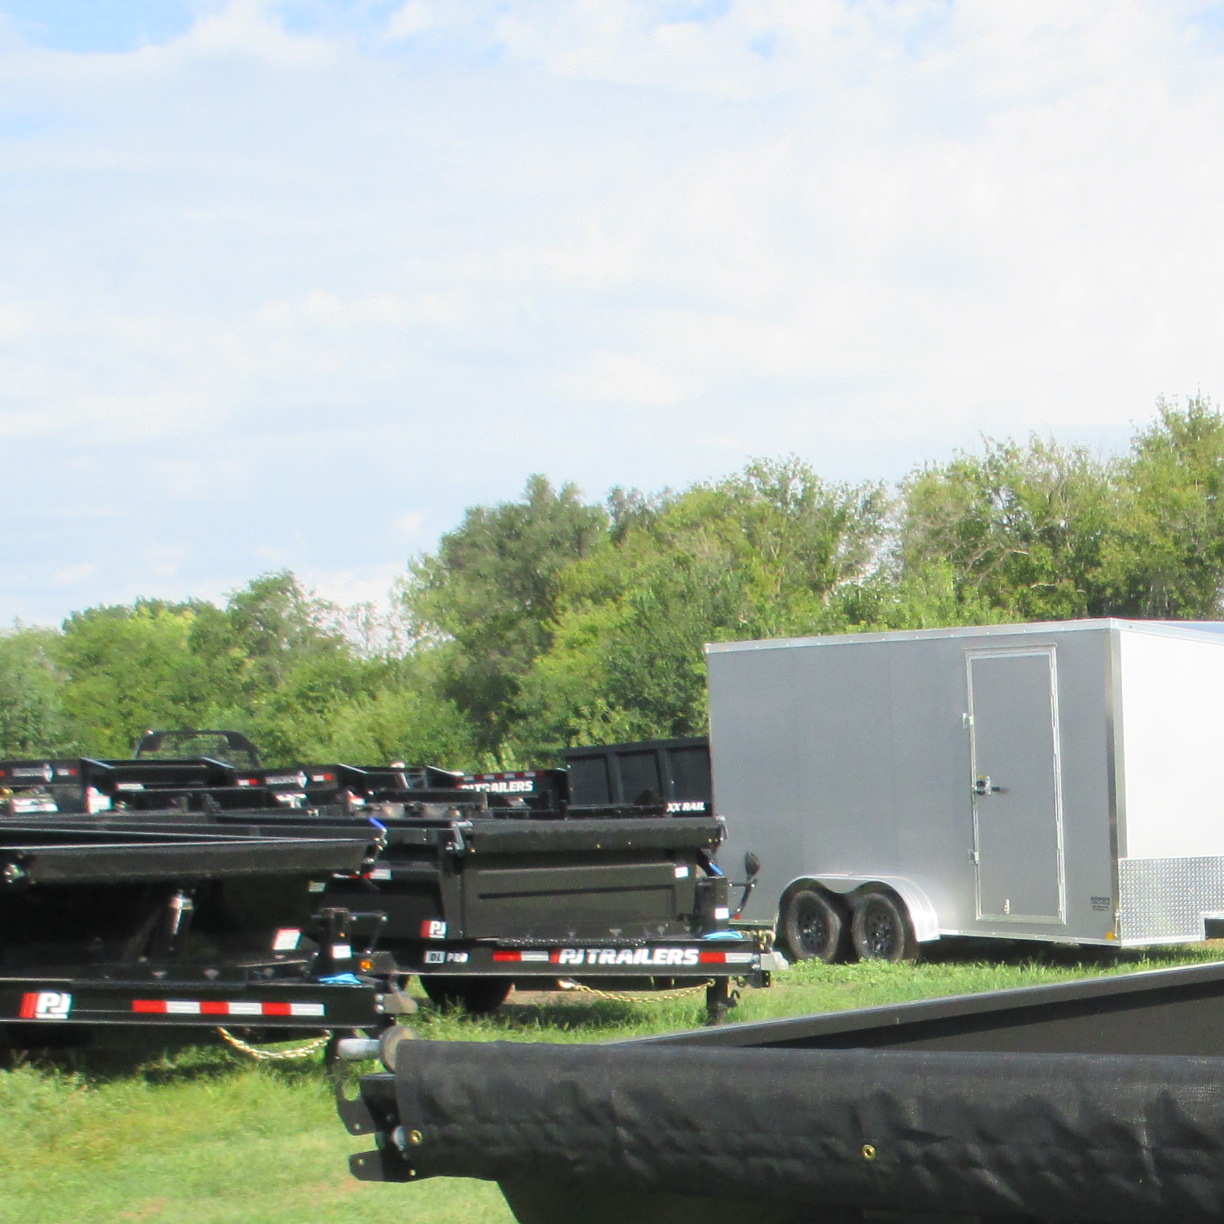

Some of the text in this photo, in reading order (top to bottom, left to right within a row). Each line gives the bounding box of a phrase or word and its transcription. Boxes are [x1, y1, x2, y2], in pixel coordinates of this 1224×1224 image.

[682, 801, 706, 811] RAIL
[428, 920, 447, 934] PJ
[558, 948, 699, 965] PJ TRAILERS
[36, 992, 72, 1013] PJ
